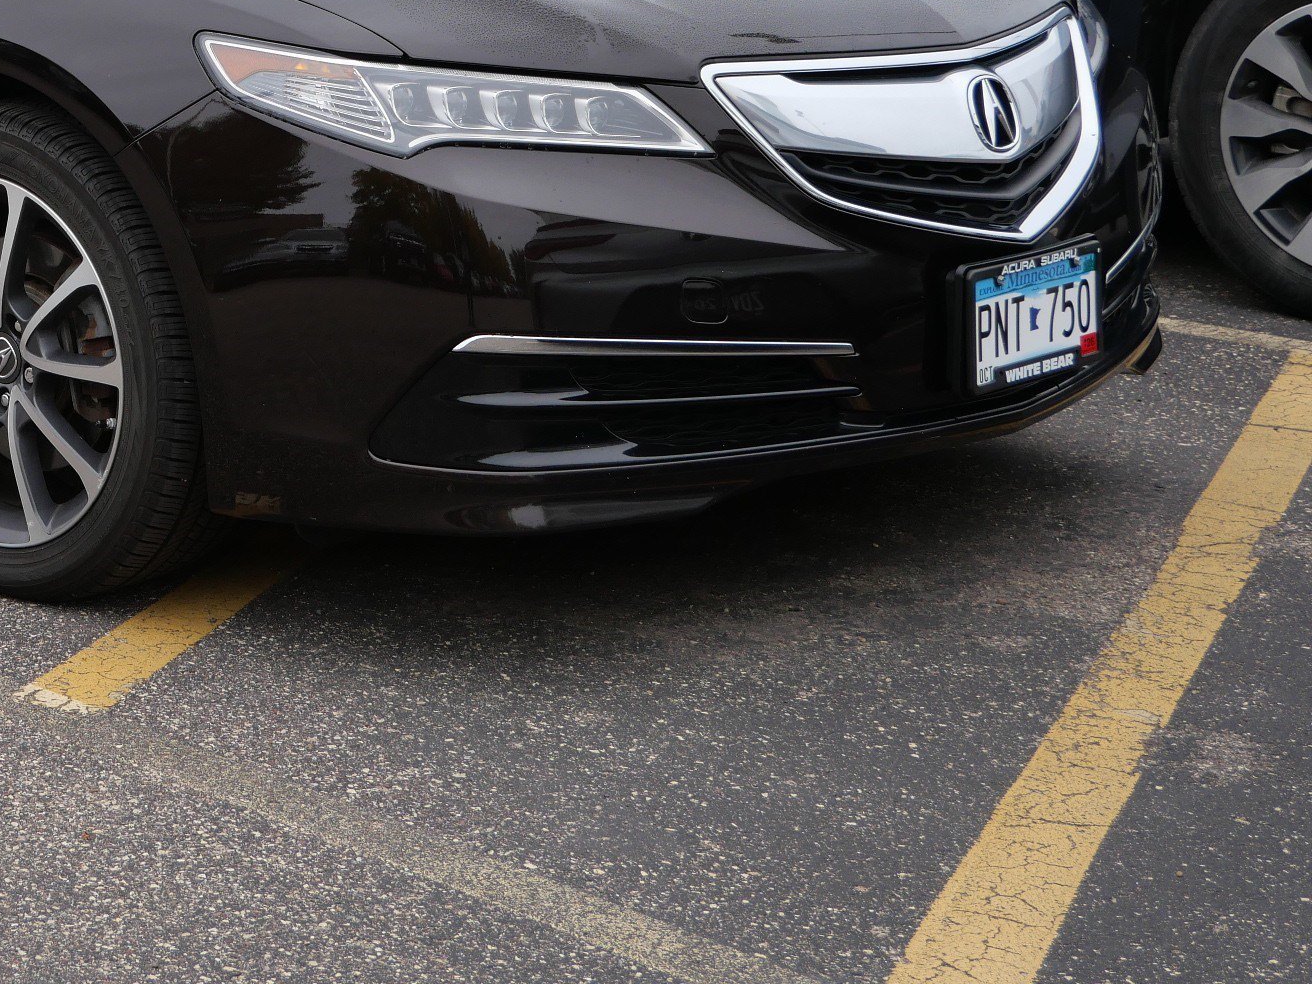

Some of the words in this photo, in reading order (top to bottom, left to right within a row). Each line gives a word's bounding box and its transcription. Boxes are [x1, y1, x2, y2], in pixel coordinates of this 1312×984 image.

[1001, 259, 1036, 276] ACURA
[1040, 248, 1078, 266] SUBARU
[978, 295, 1025, 363] PNT
[1046, 278, 1090, 343] 750
[979, 365, 993, 384] OCT
[1005, 362, 1041, 383] WHITE
[1042, 353, 1074, 373] BEAR
